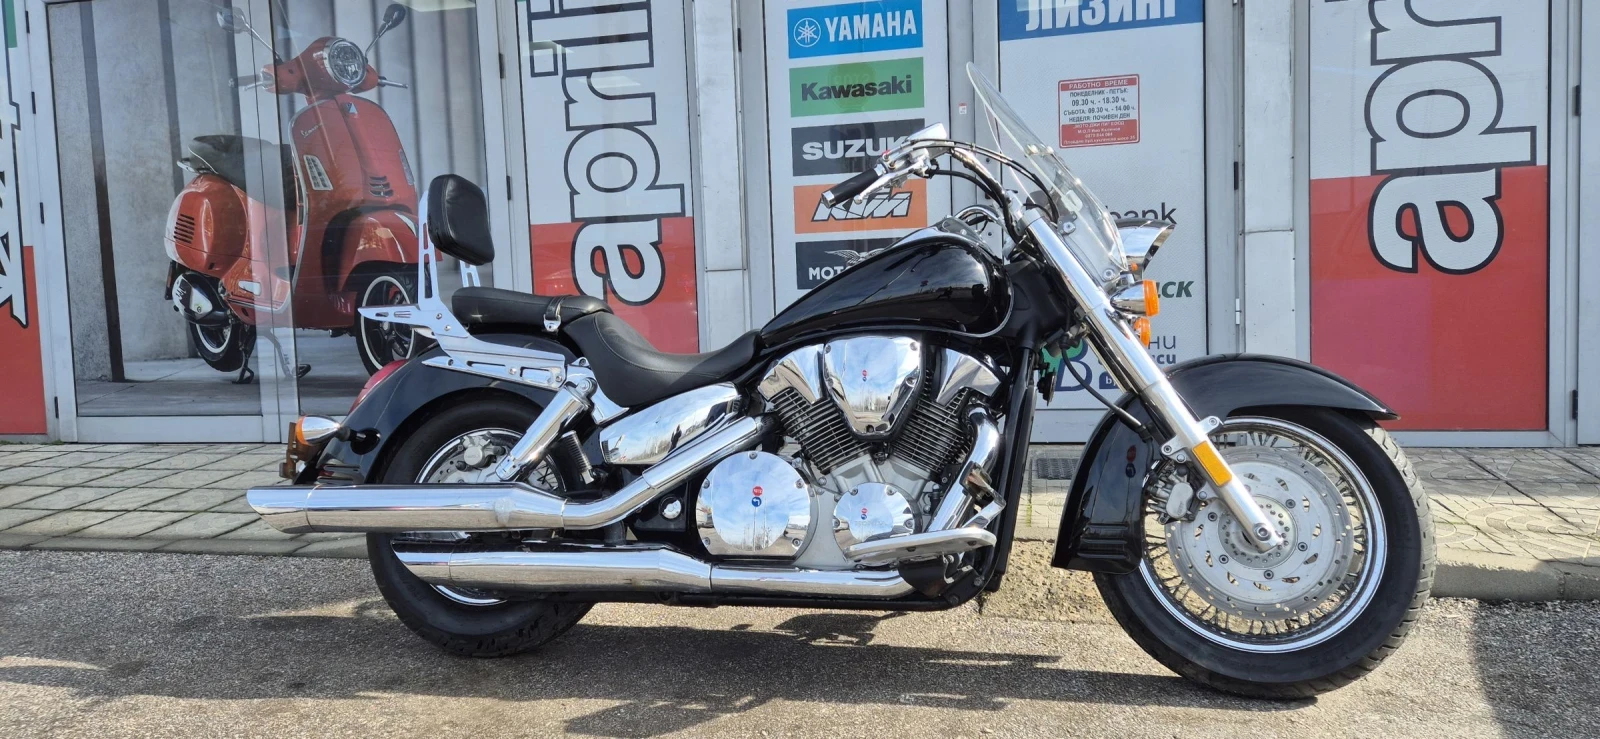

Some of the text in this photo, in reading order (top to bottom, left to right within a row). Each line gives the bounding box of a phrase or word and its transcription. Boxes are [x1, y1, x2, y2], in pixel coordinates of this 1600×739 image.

[824, 9, 917, 43] YAMAHA
[801, 74, 912, 101] Kawasaki
[1069, 79, 1128, 89] РАБОТНО ВРЕМЕ
[1070, 89, 1105, 98] ПОНЕДЕЛНИК
[1072, 98, 1089, 107] 09.30
[1102, 96, 1120, 104] 18.30
[1088, 106, 1104, 114] 09.30
[1115, 104, 1130, 112] 14.00
[1362, 0, 1537, 275] apr
[802, 135, 908, 161] SUZUK
[808, 265, 852, 280] MOT
